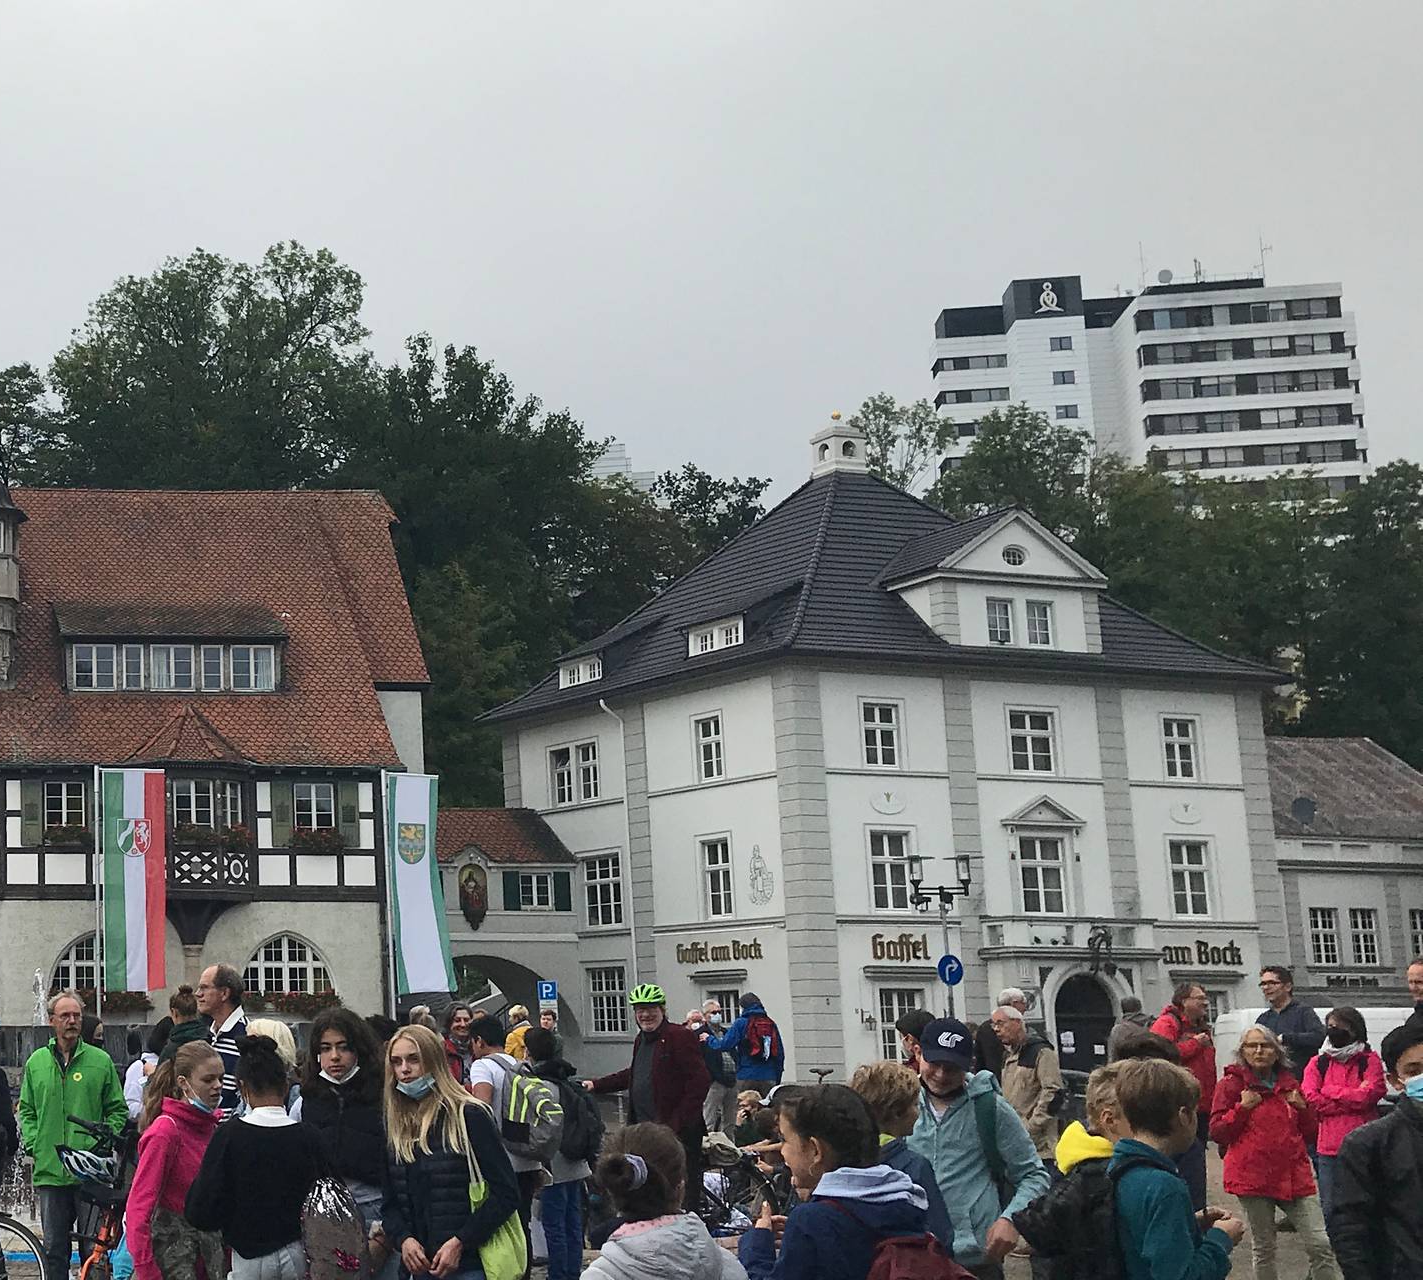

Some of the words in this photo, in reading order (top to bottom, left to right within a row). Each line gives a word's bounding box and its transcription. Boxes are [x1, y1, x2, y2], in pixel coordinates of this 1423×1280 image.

[676, 941, 709, 964] Gaffel
[711, 945, 731, 961] am
[732, 938, 763, 960] Bock
[872, 933, 931, 963] Gaffel
[1162, 945, 1194, 965] am
[1195, 939, 1243, 965] Bock
[542, 983, 553, 998] P
